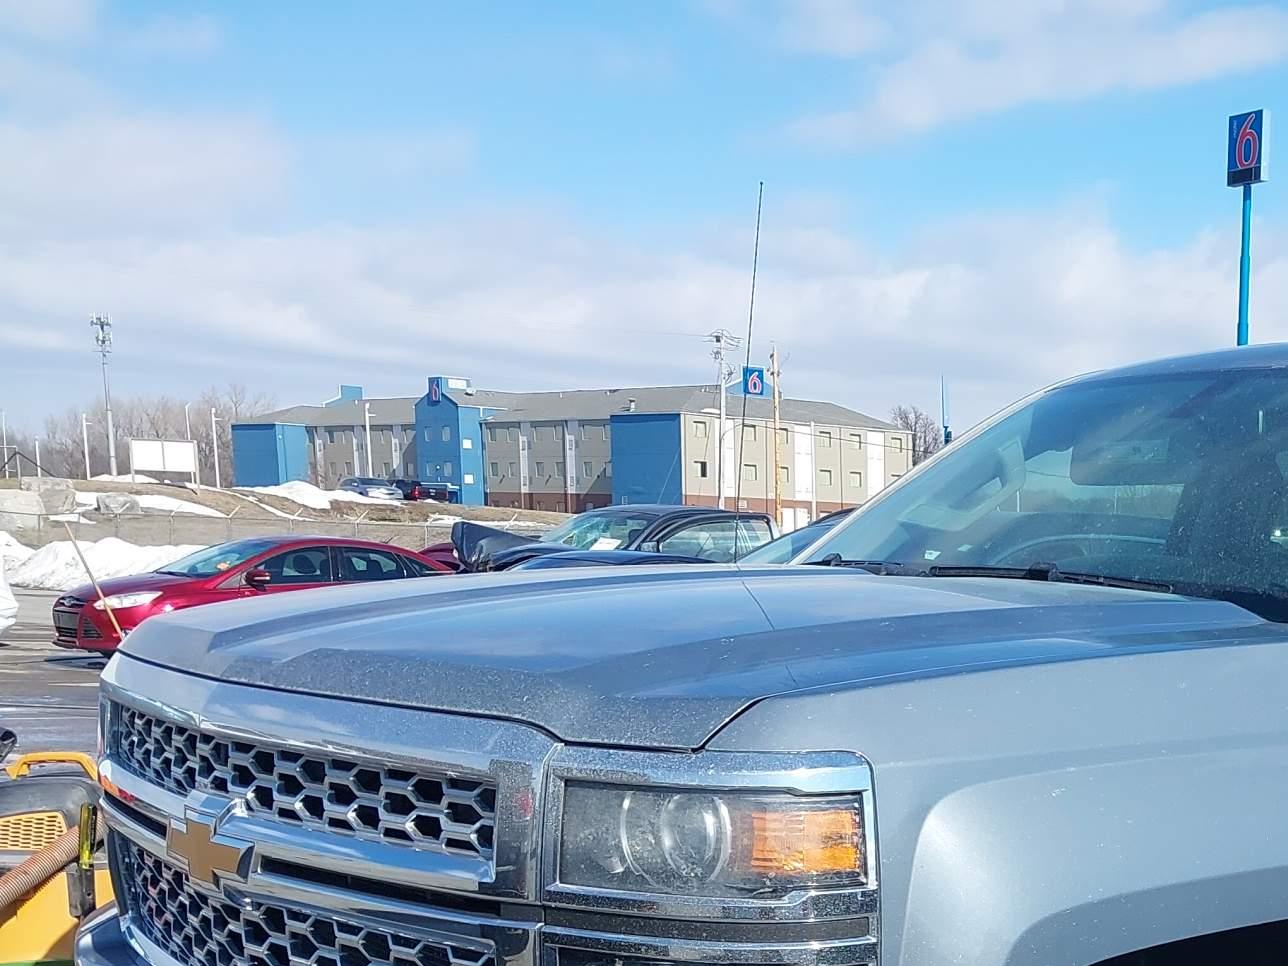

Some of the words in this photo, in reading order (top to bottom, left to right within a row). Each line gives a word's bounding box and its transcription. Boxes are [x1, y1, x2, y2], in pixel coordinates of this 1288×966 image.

[1235, 113, 1259, 169] 6
[432, 379, 439, 401] 6
[748, 371, 762, 393] 6
